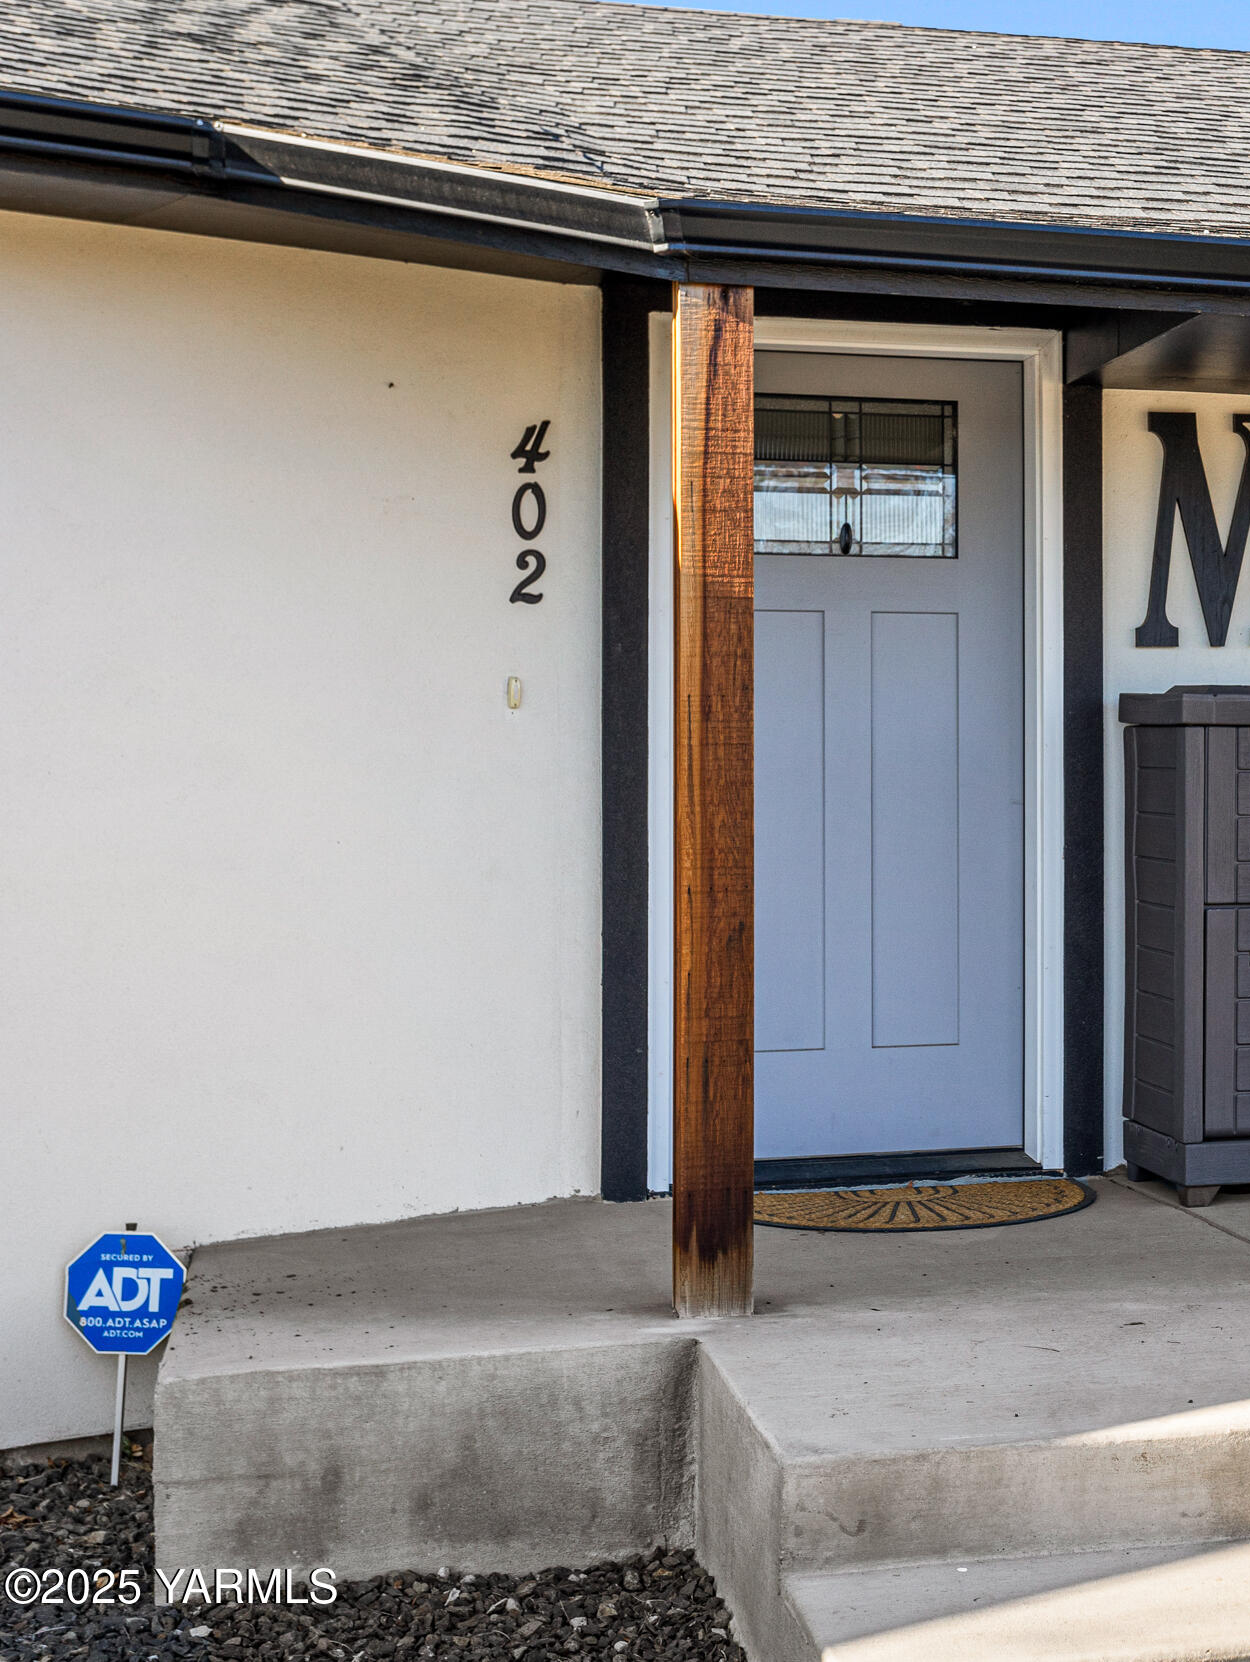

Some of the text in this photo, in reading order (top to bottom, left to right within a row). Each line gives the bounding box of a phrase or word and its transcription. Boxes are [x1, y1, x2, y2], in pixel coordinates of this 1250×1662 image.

[509, 420, 551, 605] 402
[101, 1253, 154, 1262] SECURED BY
[76, 1266, 174, 1312] ADT
[79, 1316, 167, 1328] 800.ADT.ASAP
[102, 1330, 144, 1338] ADT.COM
